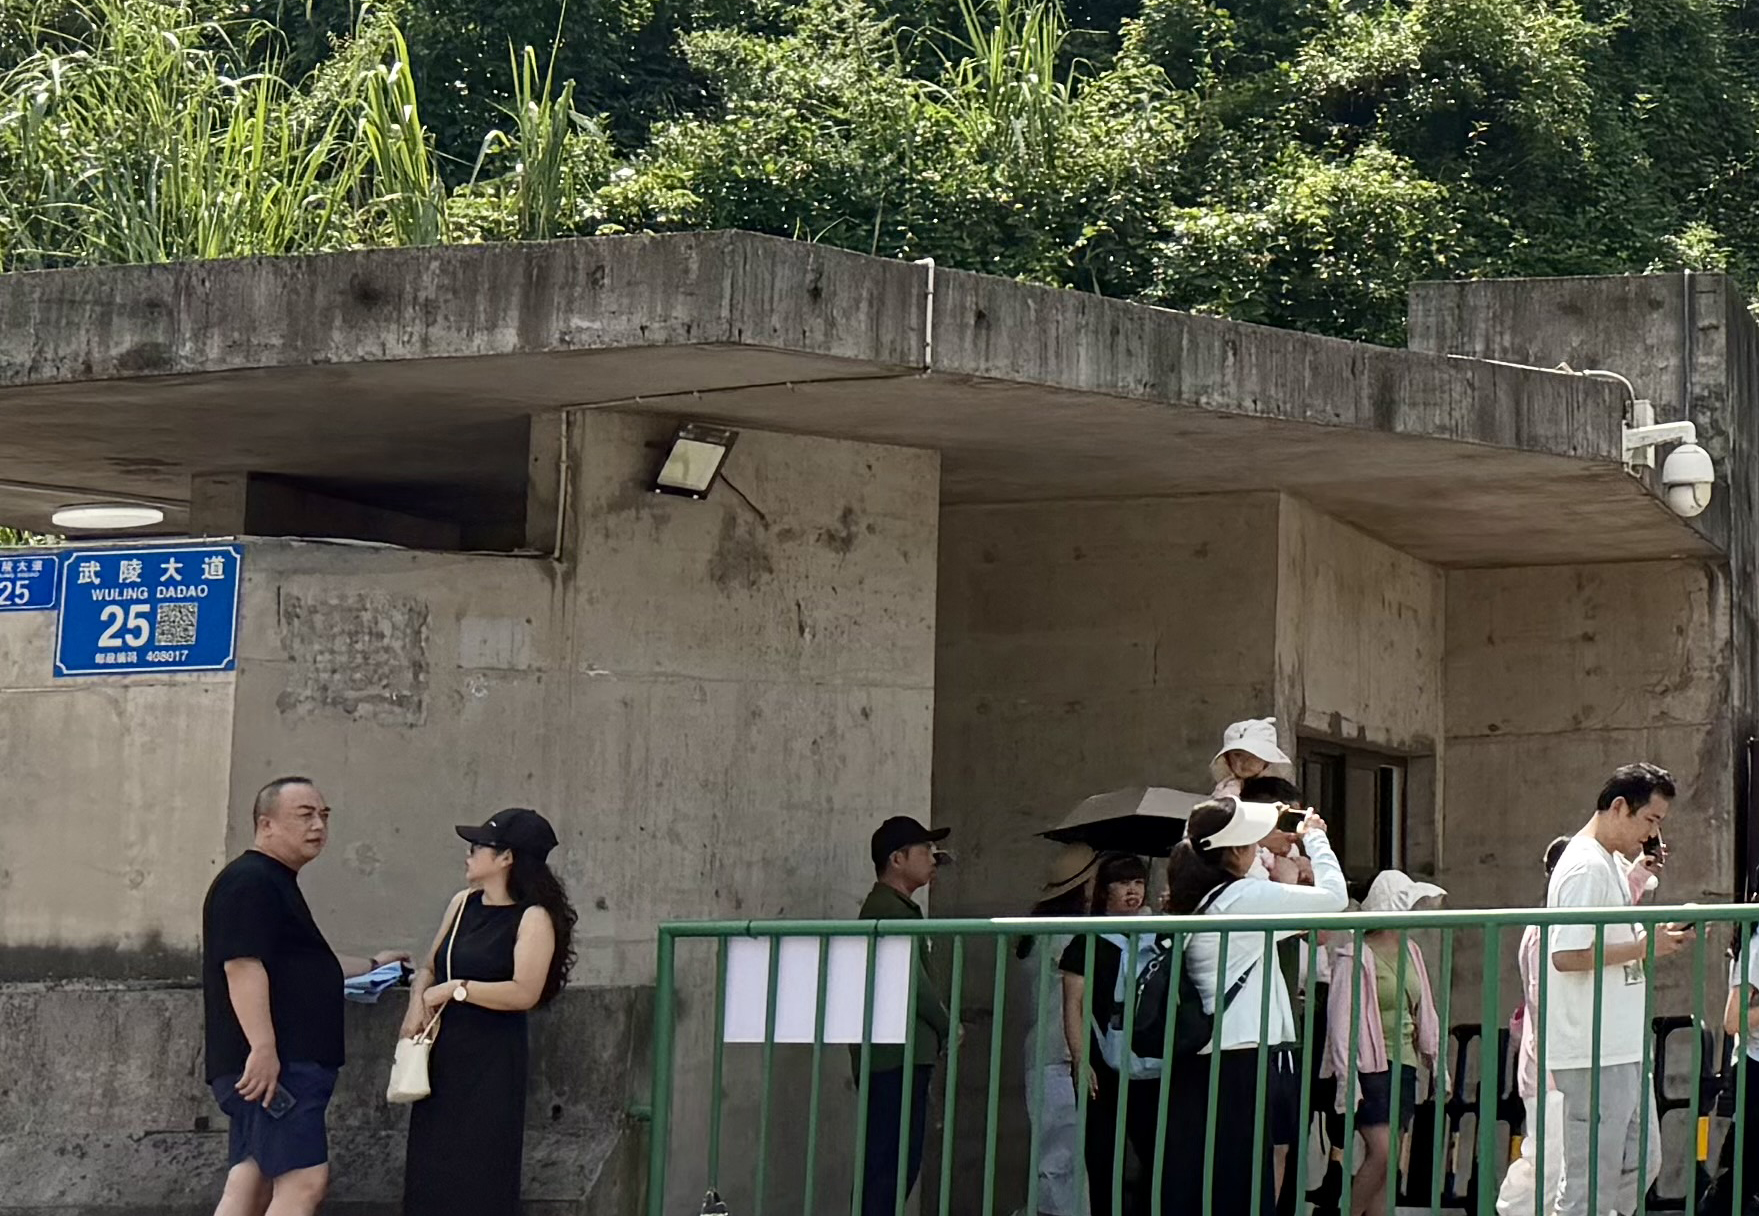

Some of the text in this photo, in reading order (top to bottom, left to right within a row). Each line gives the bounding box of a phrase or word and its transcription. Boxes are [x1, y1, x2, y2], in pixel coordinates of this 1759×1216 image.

[77, 556, 225, 584] 武陵大道
[0, 580, 29, 605] 25
[92, 585, 208, 601] WULING DADAO
[98, 604, 150, 647] 25
